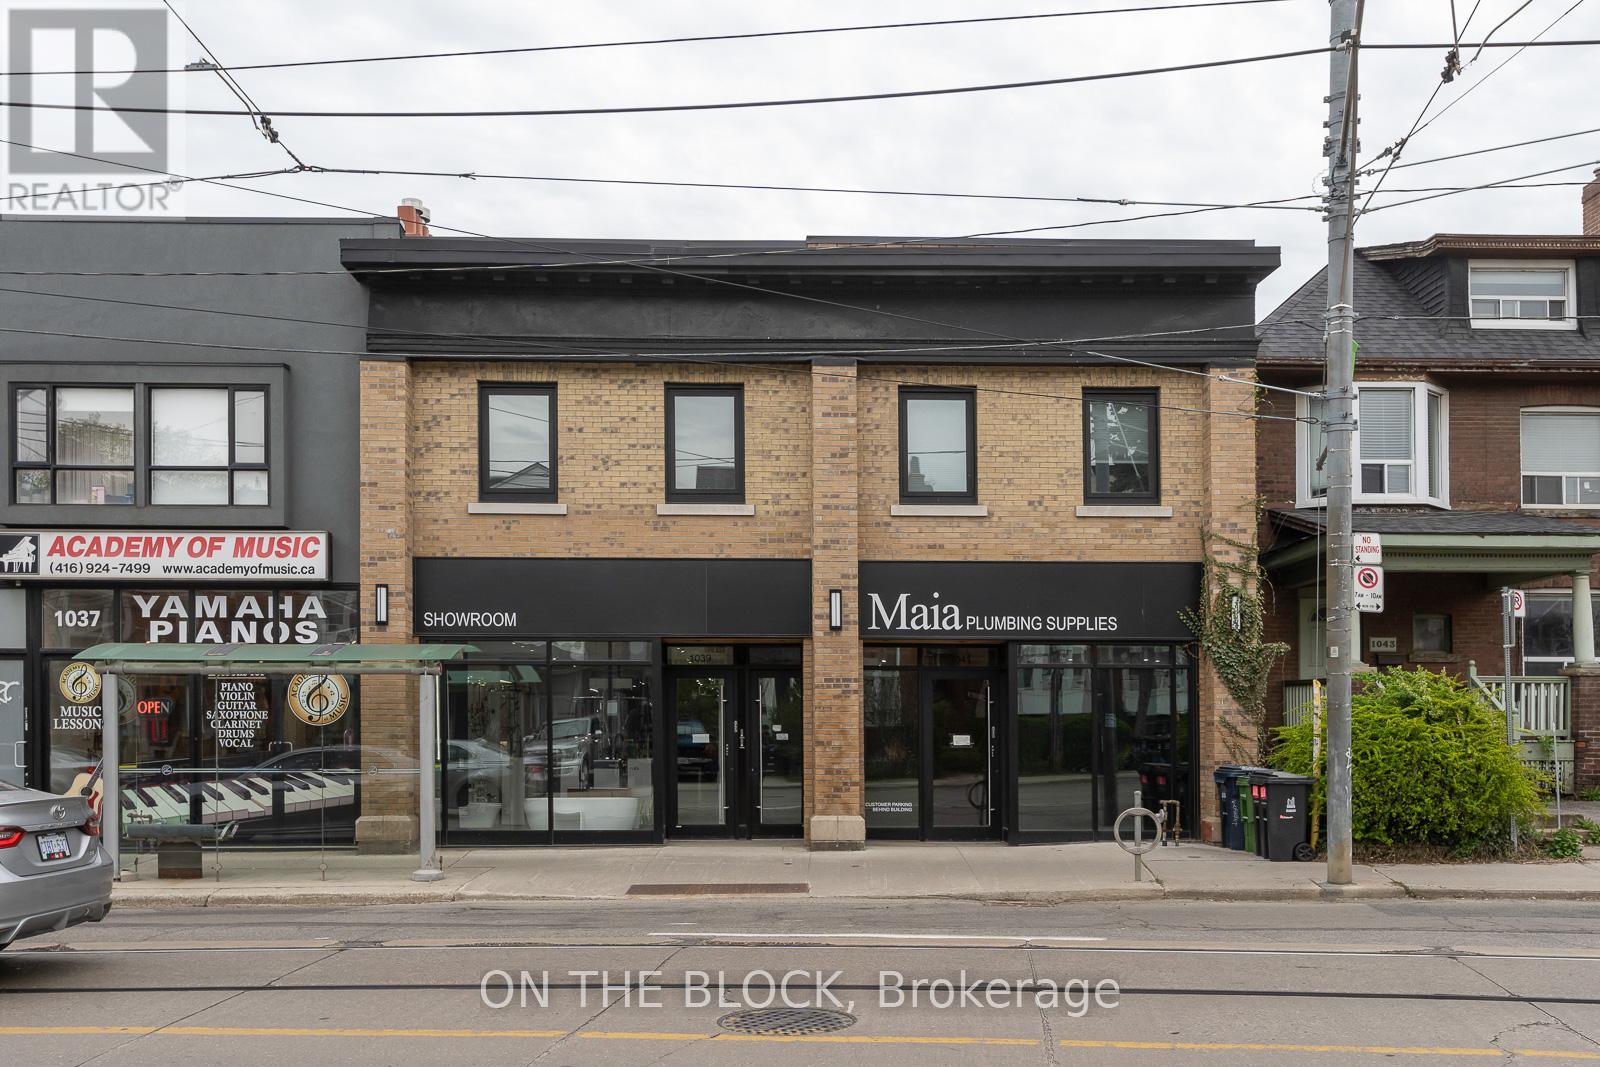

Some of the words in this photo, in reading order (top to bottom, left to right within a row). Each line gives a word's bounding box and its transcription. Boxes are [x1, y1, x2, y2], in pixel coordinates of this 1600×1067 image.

[1362, 536, 1371, 544] NO
[47, 536, 184, 558] ACADEMY
[187, 536, 226, 558] OF
[233, 536, 320, 559] MUSIC
[1354, 546, 1380, 554] STANDING
[162, 563, 316, 577] www.academyofmusic.ca
[132, 595, 328, 619] YAMAHA
[867, 591, 964, 631] Maia
[966, 615, 1043, 631] PLUMBING
[1046, 615, 1119, 631] SUPPLIES
[54, 610, 101, 627] 1037
[423, 611, 518, 628] SHOWROOM
[149, 620, 320, 644] PIANOS
[1371, 640, 1396, 648] 1043
[220, 682, 253, 692] PIANO
[219, 692, 255, 701] VIOLIN
[60, 705, 102, 717] MUSIC
[137, 700, 170, 714] OPEN
[217, 701, 257, 710] GUITAR
[328, 693, 348, 720] MUSIC
[206, 710, 269, 720] SAXOPHONE
[53, 718, 104, 730] LESSON
[210, 720, 263, 729] CLARINET
[218, 729, 255, 738] DRUMS
[218, 738, 254, 748] VOCAL
